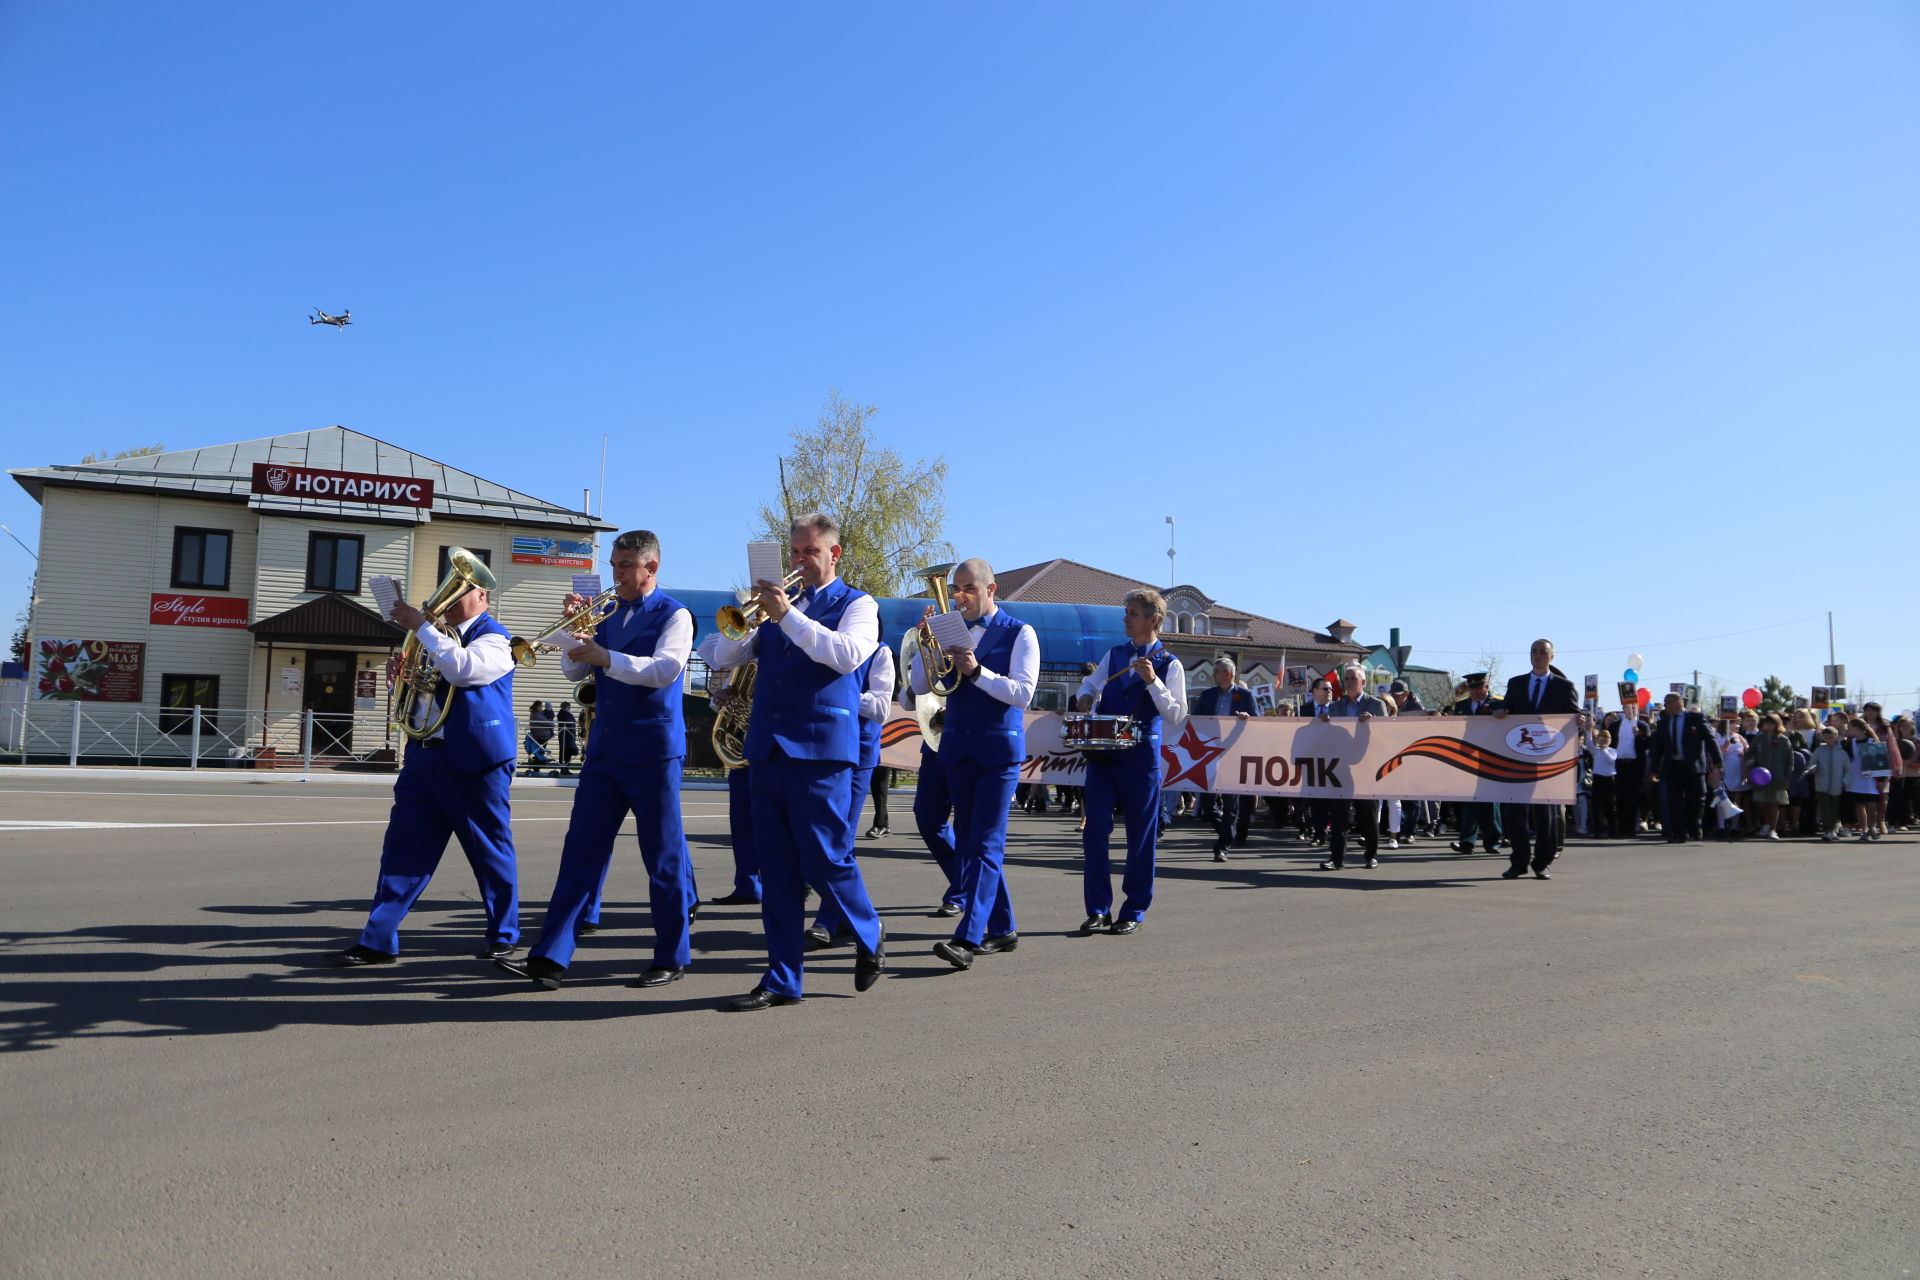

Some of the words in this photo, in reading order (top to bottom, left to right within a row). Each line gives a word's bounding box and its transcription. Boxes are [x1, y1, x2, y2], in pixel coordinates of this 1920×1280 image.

[295, 473, 422, 502] НОТАРИУС
[541, 557, 584, 566] турагентство
[152, 596, 206, 625] Style
[183, 616, 210, 624] студия
[212, 617, 247, 625] красоты
[91, 640, 108, 662] 9
[108, 653, 139, 663] МАЯ
[1239, 755, 1343, 788] ПОЛК
